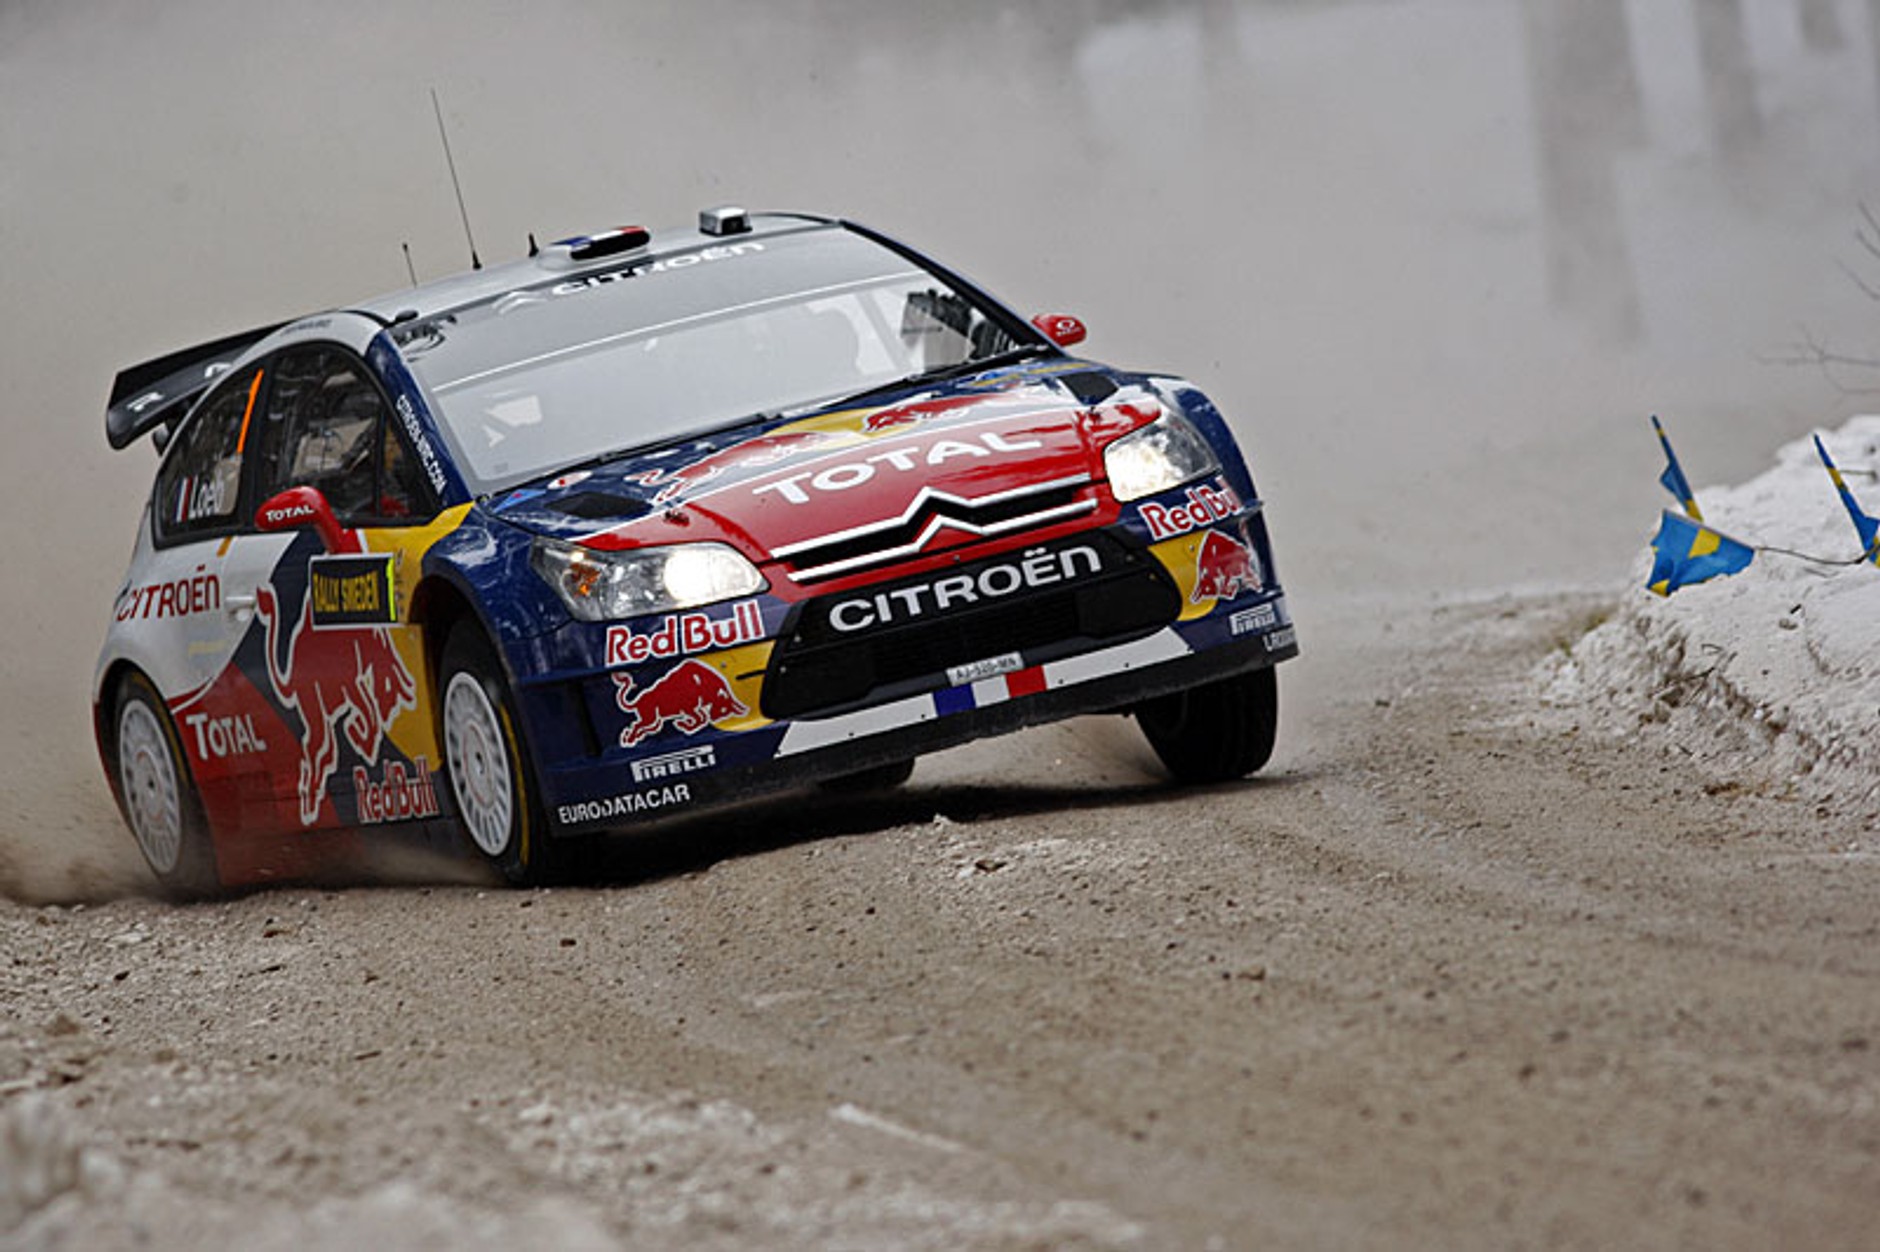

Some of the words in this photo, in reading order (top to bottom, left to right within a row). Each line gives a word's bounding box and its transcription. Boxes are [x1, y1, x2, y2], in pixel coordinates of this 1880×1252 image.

[753, 431, 1043, 505] TOTAL
[265, 505, 315, 522] TOTAL
[1137, 487, 1214, 541] Red
[829, 547, 1102, 632] CITROËN
[606, 615, 679, 668] Red
[681, 600, 765, 653] Bull
[185, 712, 267, 761] TOTAL
[353, 759, 396, 823] Red
[392, 755, 439, 820] Bull
[630, 745, 716, 783] PIRELLI
[557, 784, 691, 824] EURODATACAR
